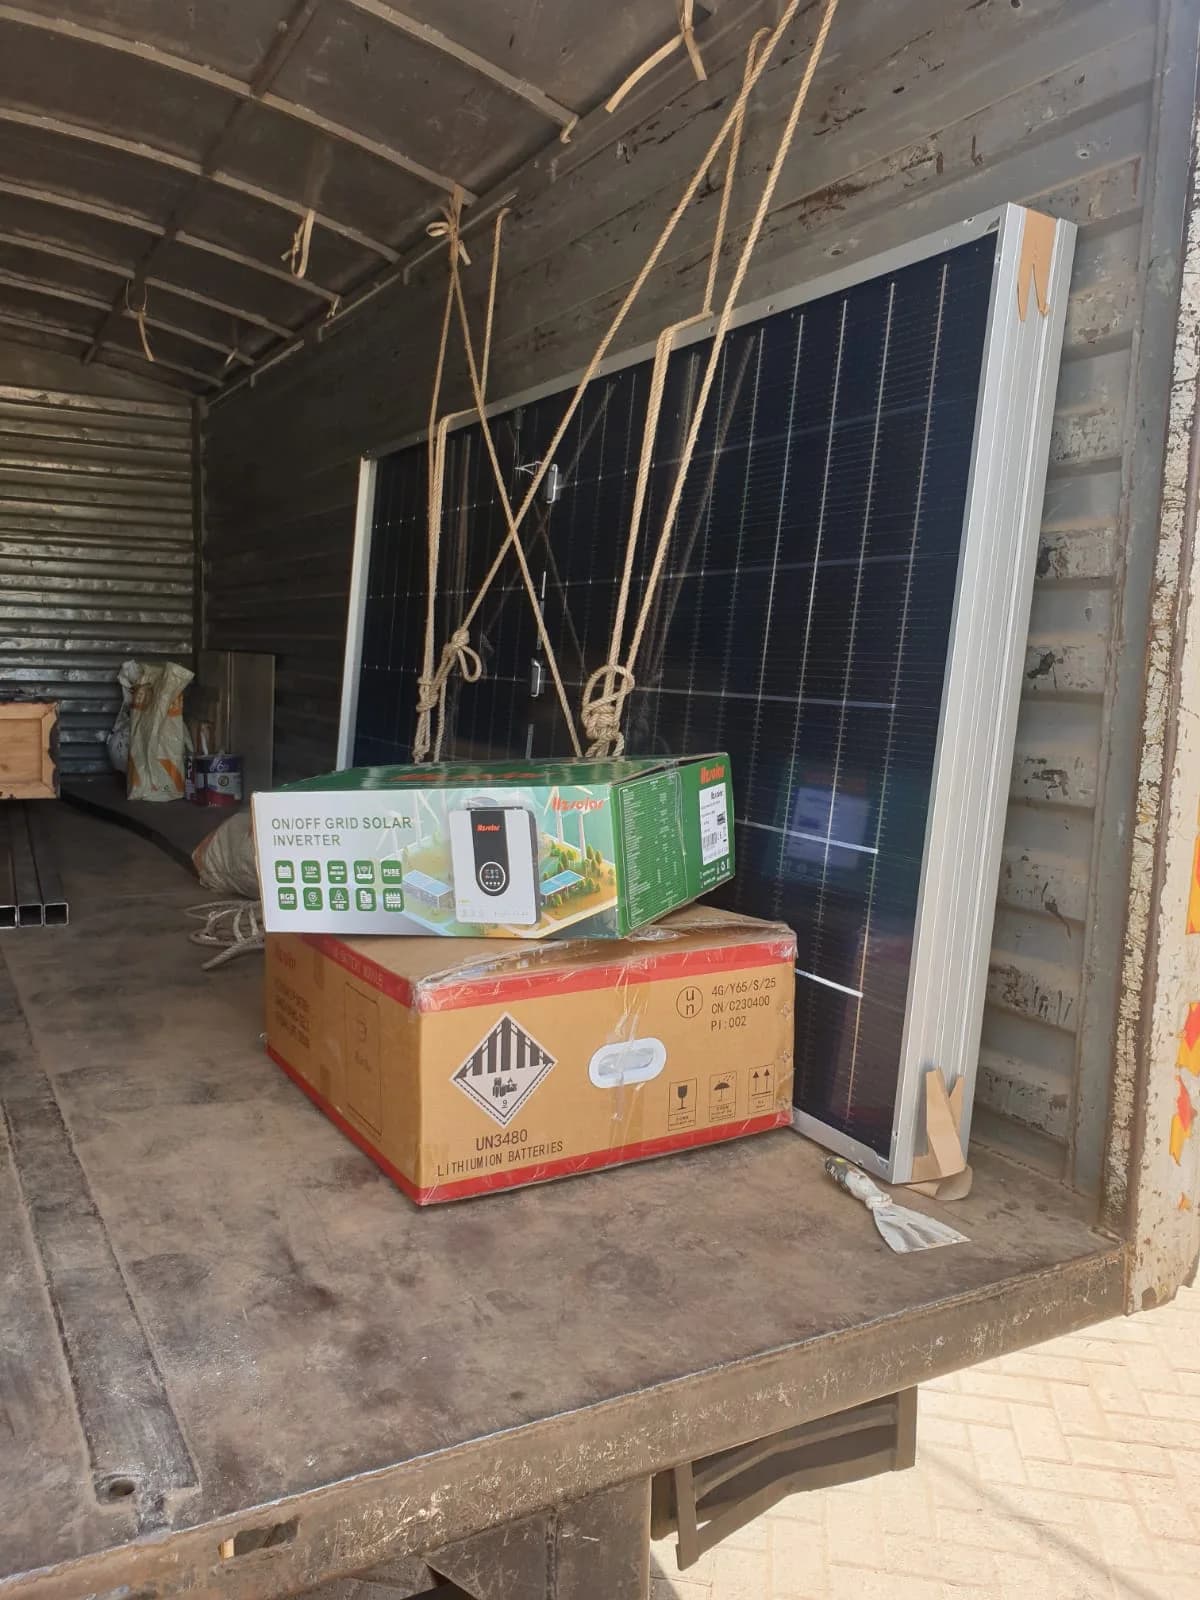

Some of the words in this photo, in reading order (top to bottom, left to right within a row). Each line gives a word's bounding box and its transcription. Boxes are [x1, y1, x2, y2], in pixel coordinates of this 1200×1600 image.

[272, 818, 321, 830] ON/OFF
[325, 817, 359, 830] GRID
[363, 816, 412, 829] SOLAR
[273, 834, 341, 846] INVERTER
[711, 977, 776, 997] 4G/Y65/S/25
[711, 995, 770, 1015] CN/C230400
[476, 1128, 528, 1151] UN3480
[508, 1140, 563, 1163] BATTERIES
